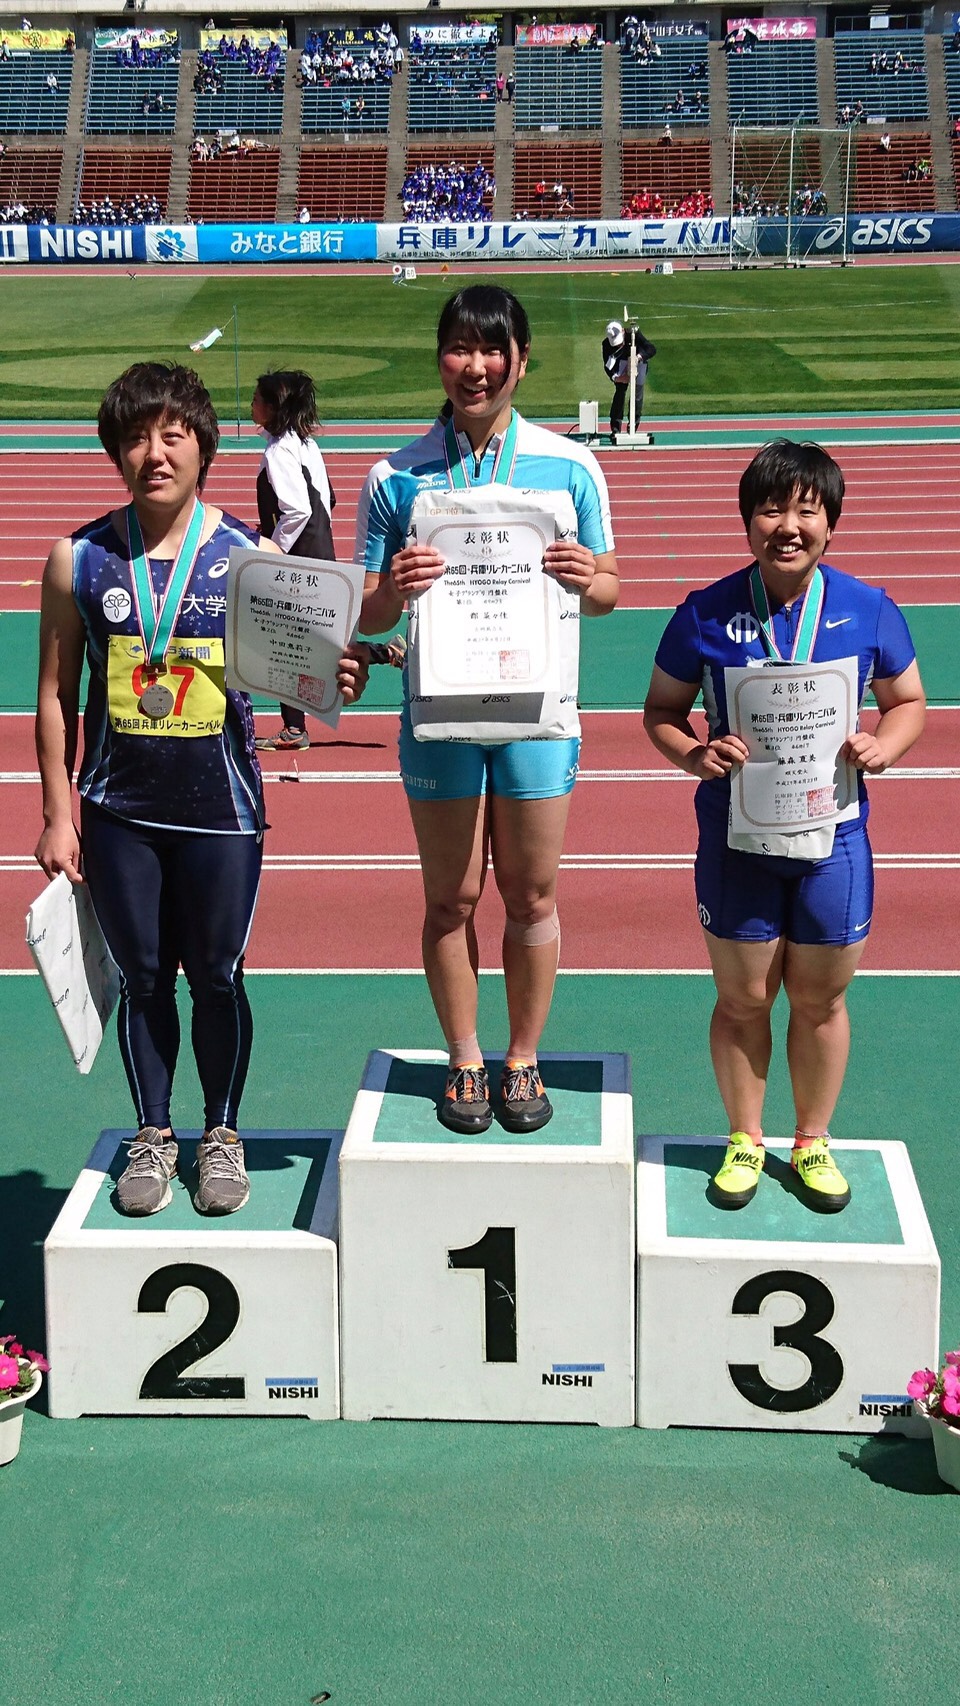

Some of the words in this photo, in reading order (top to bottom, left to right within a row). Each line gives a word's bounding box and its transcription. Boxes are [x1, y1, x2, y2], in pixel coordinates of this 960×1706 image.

[230, 231, 344, 254] みなと銀行
[396, 221, 737, 249] 兵庫リレーカーニバル
[40, 229, 133, 258] NISHI
[464, 531, 509, 544] 表彰状
[274, 570, 319, 587] 表彰状
[168, 646, 210, 660] 戸新聞
[771, 680, 816, 695] 表彰状
[731, 1152, 759, 1166] NIKE
[802, 1154, 828, 1168] NIKE
[447, 1227, 517, 1363] 1
[138, 1263, 246, 1399] 2
[728, 1270, 844, 1412] 3
[541, 1373, 593, 1387] NISHI
[268, 1387, 319, 1399] NISHI
[859, 1404, 912, 1417] NISHI
